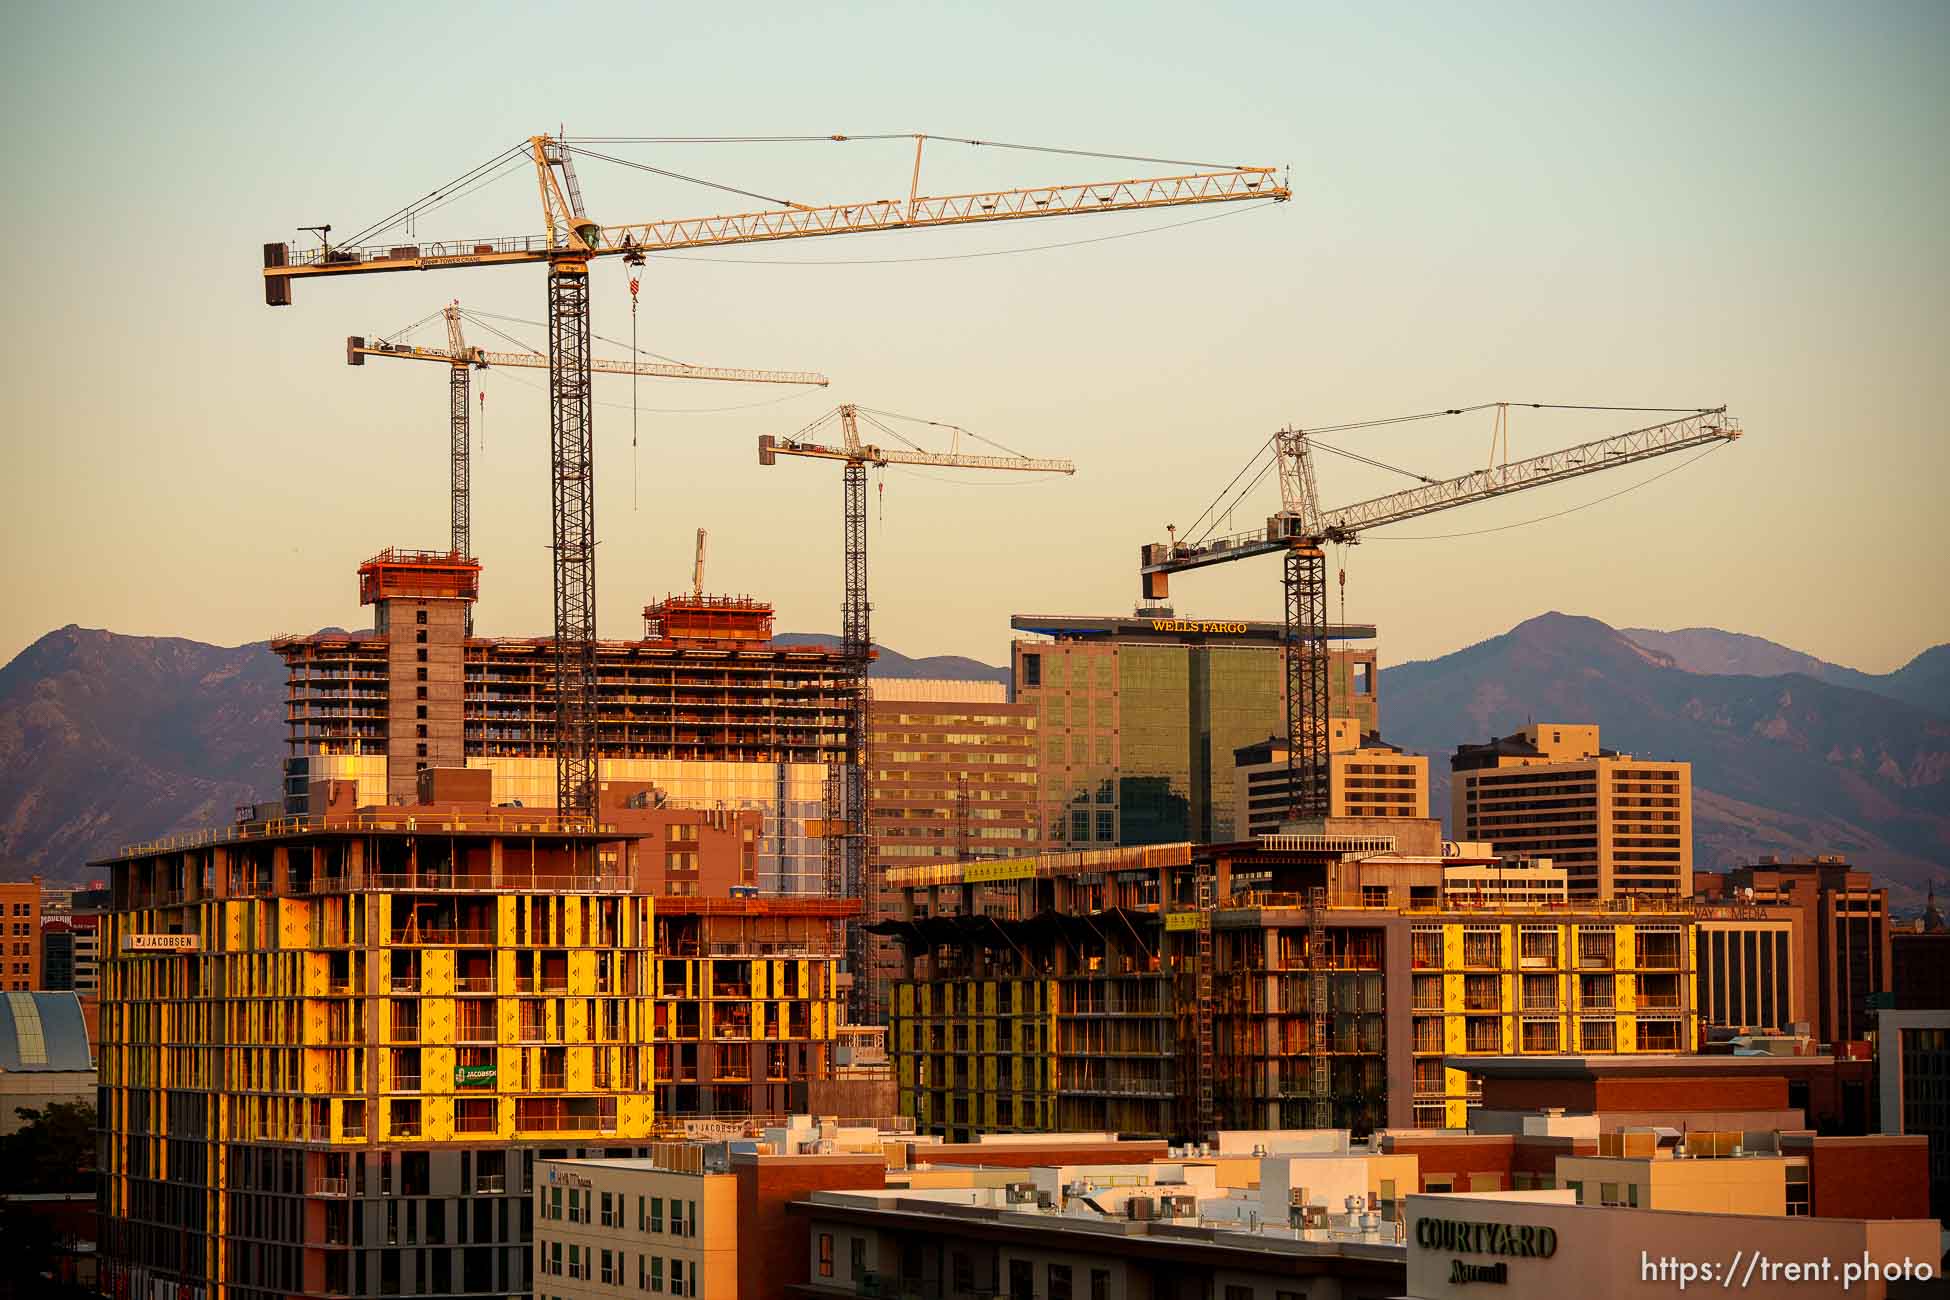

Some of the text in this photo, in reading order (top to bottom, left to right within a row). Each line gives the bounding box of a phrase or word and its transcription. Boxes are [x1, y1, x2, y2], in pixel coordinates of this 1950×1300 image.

[1152, 620, 1247, 633] WELLS FARGO
[1730, 907, 1768, 920] MEDIA
[40, 915, 73, 928] MAVERIK
[146, 937, 192, 947] JACOBSEN
[701, 1123, 743, 1133] JACOBSEN
[1415, 1217, 1558, 1259] COURTYARD
